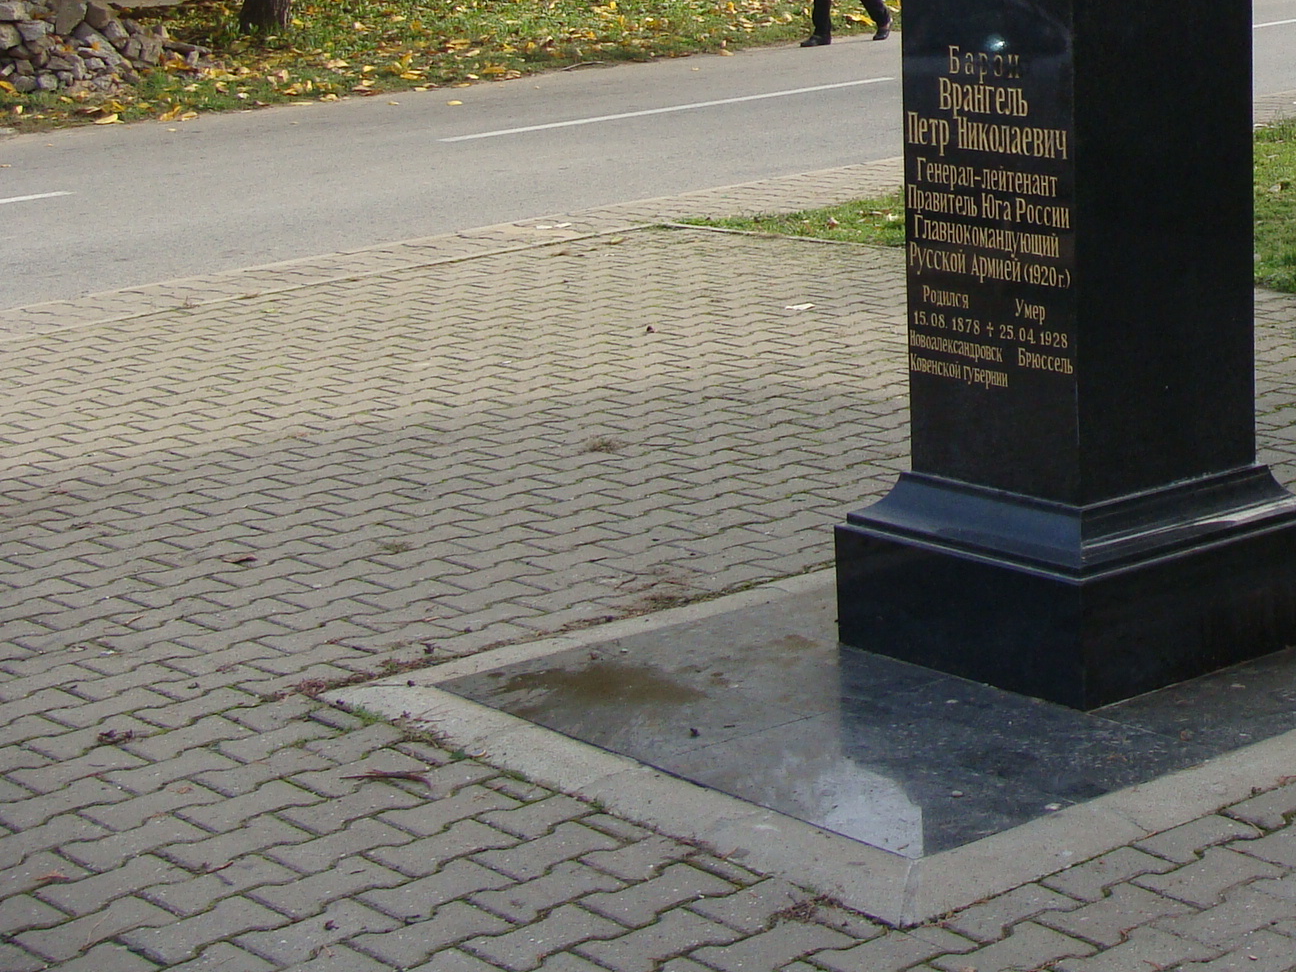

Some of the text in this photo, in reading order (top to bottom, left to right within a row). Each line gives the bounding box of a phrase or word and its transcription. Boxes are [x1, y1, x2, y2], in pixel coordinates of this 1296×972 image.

[948, 44, 1020, 84] Барон
[939, 77, 1029, 119] Врангель
[907, 111, 1068, 160] Петр Николаевич
[917, 157, 1058, 197] Генерал-лейтенант
[908, 184, 1070, 229] Правитель Юга России
[914, 214, 1060, 258] Главнокомандующий
[909, 241, 967, 275] Русской
[970, 253, 1021, 283] Армией
[922, 285, 969, 309] Родился
[1015, 298, 1046, 325] Умер
[909, 330, 1003, 362] Новоалександровск
[1018, 347, 1073, 374] Брюссель
[910, 353, 1008, 389] Ковенской губернии
